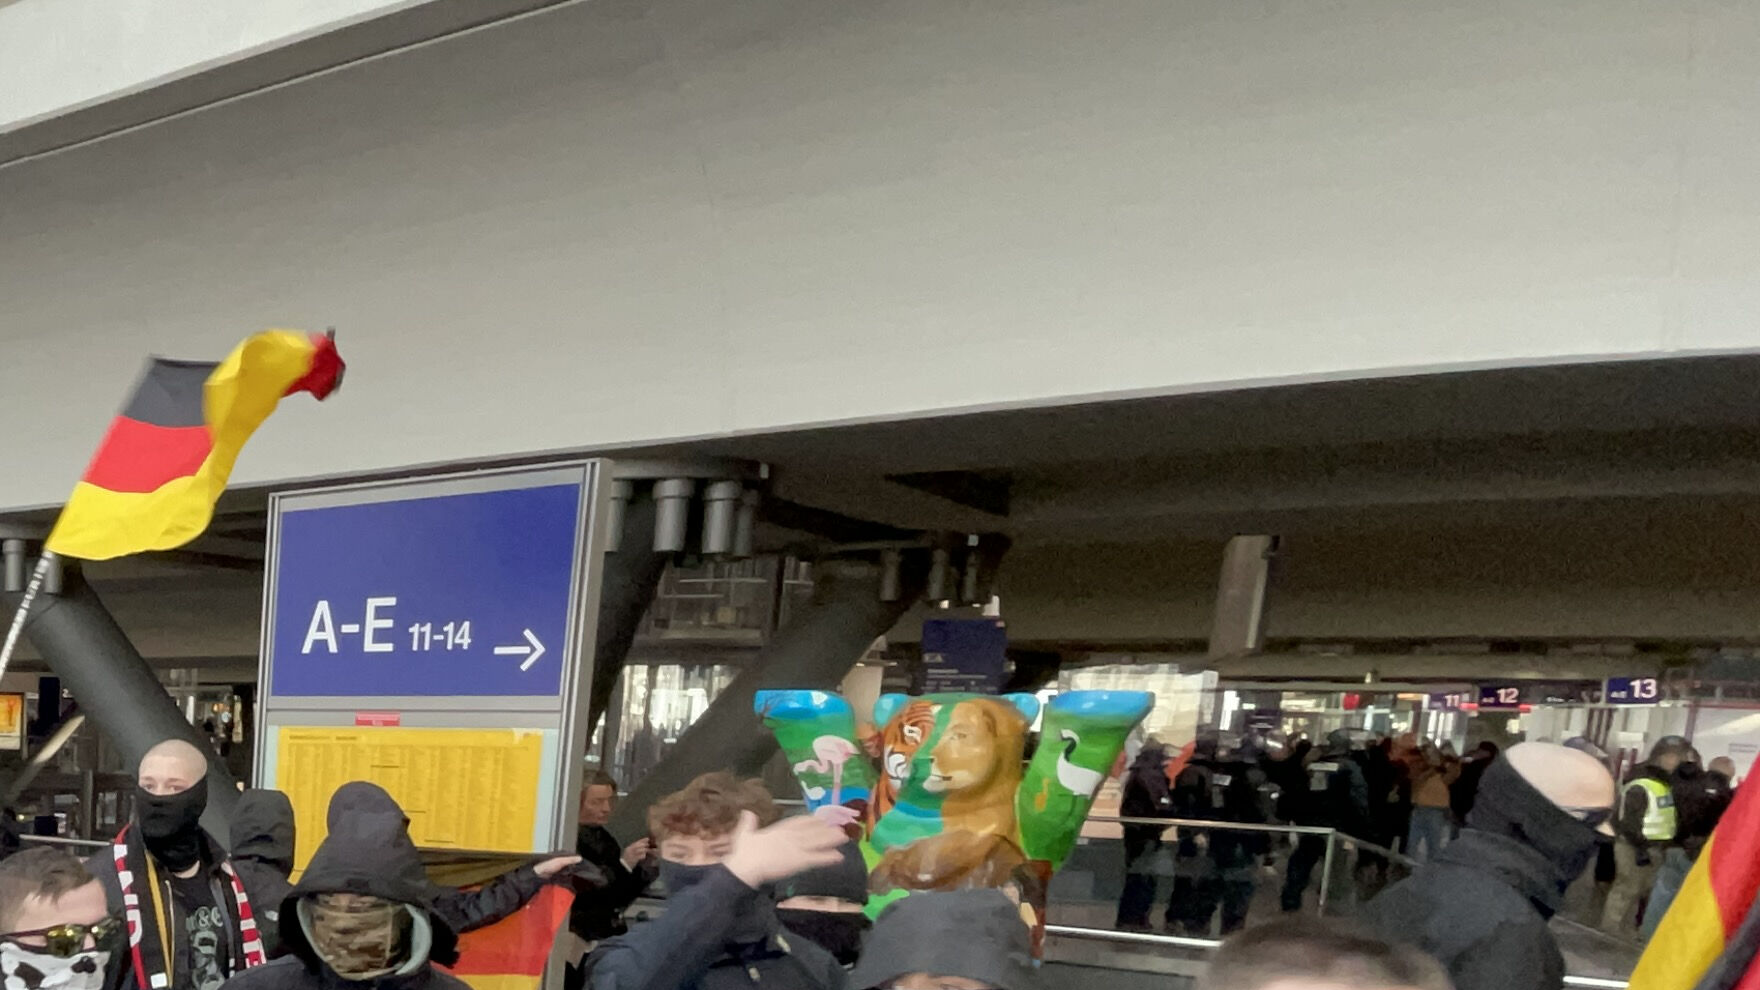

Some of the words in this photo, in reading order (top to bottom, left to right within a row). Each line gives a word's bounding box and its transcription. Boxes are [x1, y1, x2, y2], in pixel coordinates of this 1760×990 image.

[301, 597, 397, 654] A-E
[408, 620, 471, 651] 11-14
[1496, 687, 1520, 703] 12
[1629, 678, 1657, 699] 13
